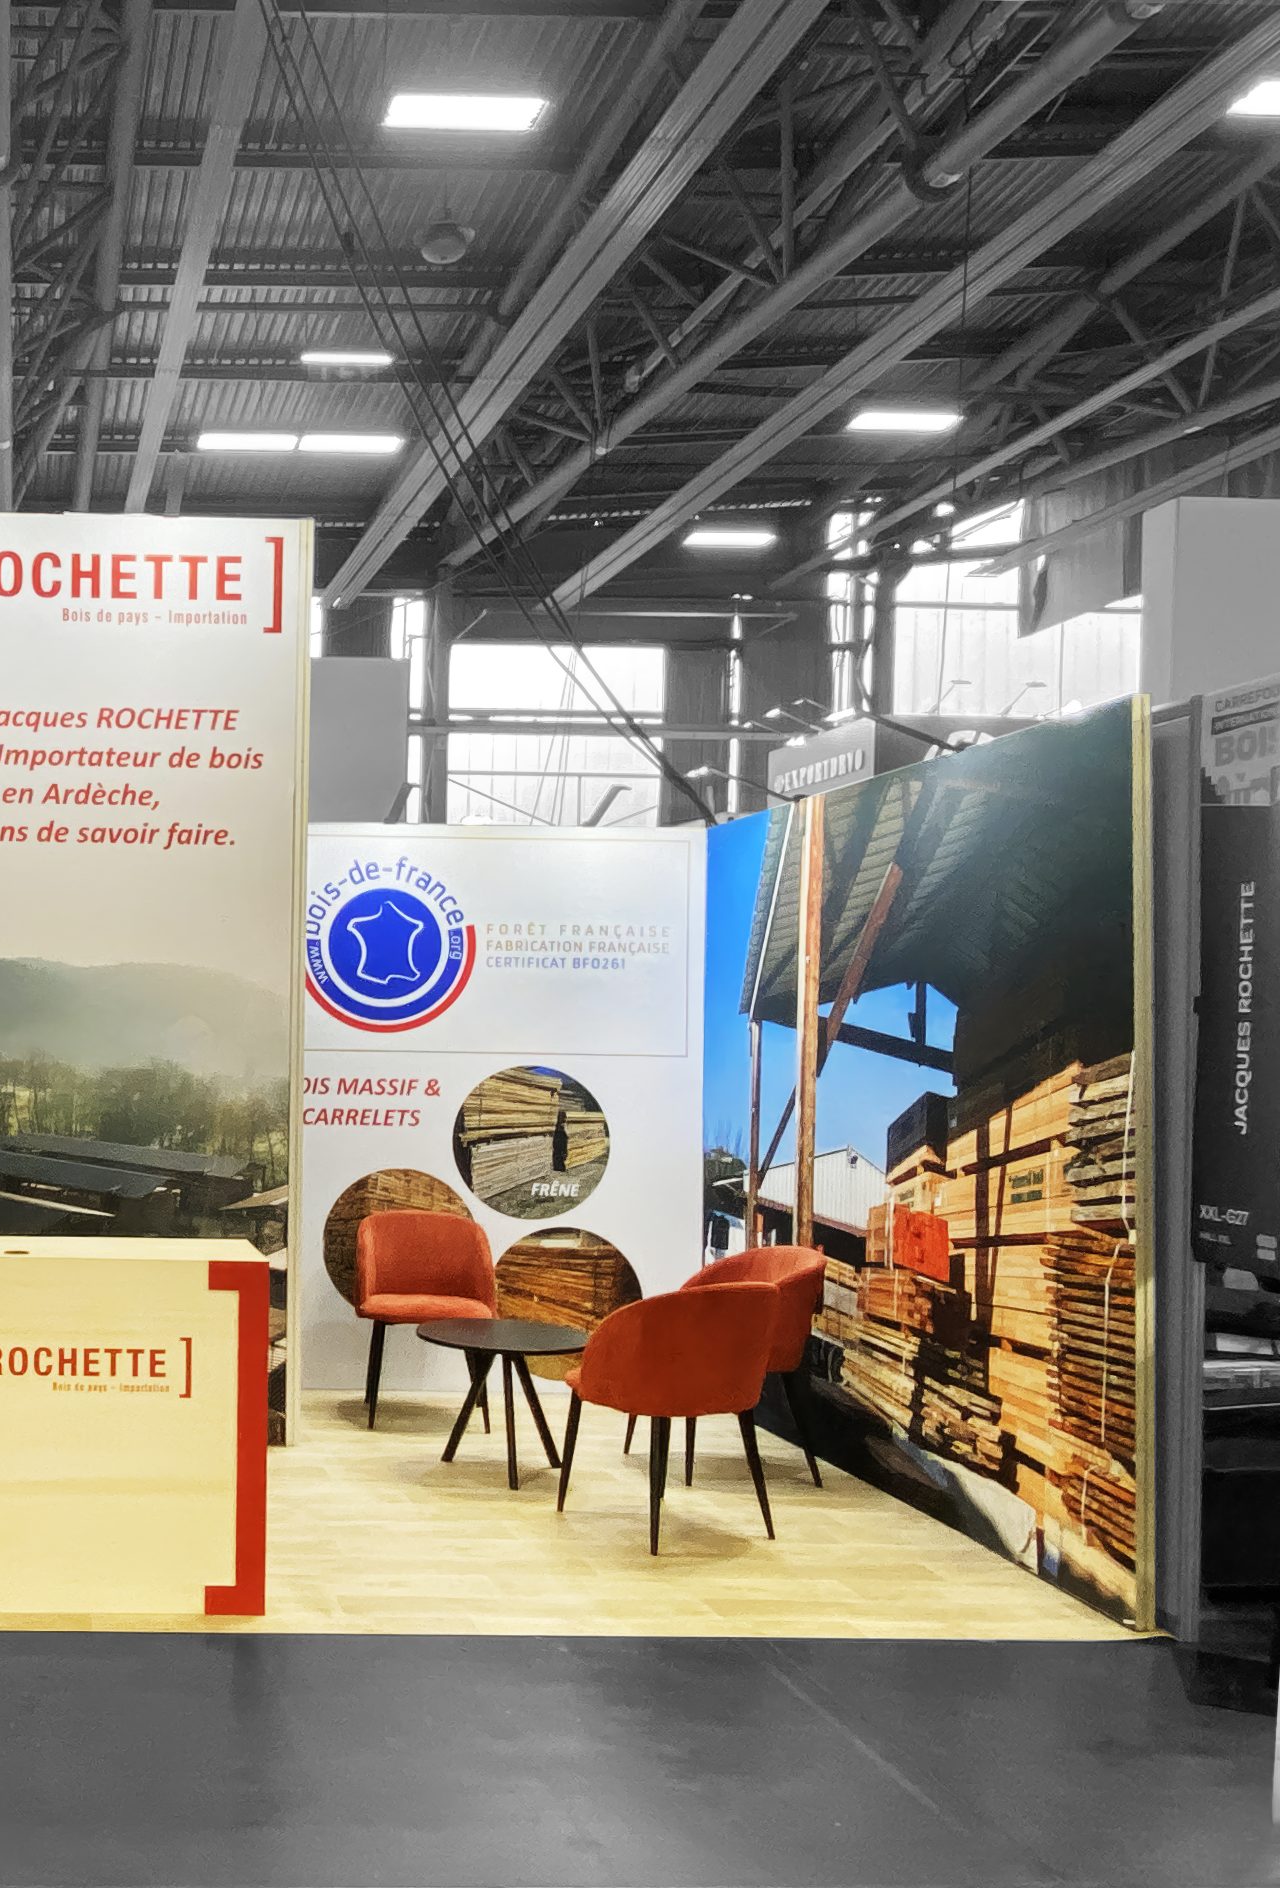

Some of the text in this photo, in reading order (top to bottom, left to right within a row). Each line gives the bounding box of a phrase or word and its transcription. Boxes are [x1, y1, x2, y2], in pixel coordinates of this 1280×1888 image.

[63, 608, 90, 622] Bois
[97, 609, 112, 622] de
[118, 612, 148, 626] pays
[169, 610, 247, 626] Importation
[97, 708, 239, 730] ROCHETTE
[169, 746, 200, 768] de
[209, 747, 263, 769] bois
[2, 788, 33, 804] en
[42, 783, 159, 810] Ardèche,
[37, 821, 69, 843] de
[77, 823, 160, 844] savoir
[163, 823, 234, 850] faire.
[487, 922, 668, 942] FORÊT FRANÇAISE
[487, 940, 669, 958] FABRICATION FRANÇAISE
[487, 957, 566, 968] CERTIFICAT
[1234, 881, 1256, 1135] JACQUES ROCHETTE
[337, 1078, 418, 1096] MASSIF
[425, 1079, 440, 1096] &
[303, 1108, 421, 1126] CARRELETS
[531, 1179, 581, 1199] FRÊNE
